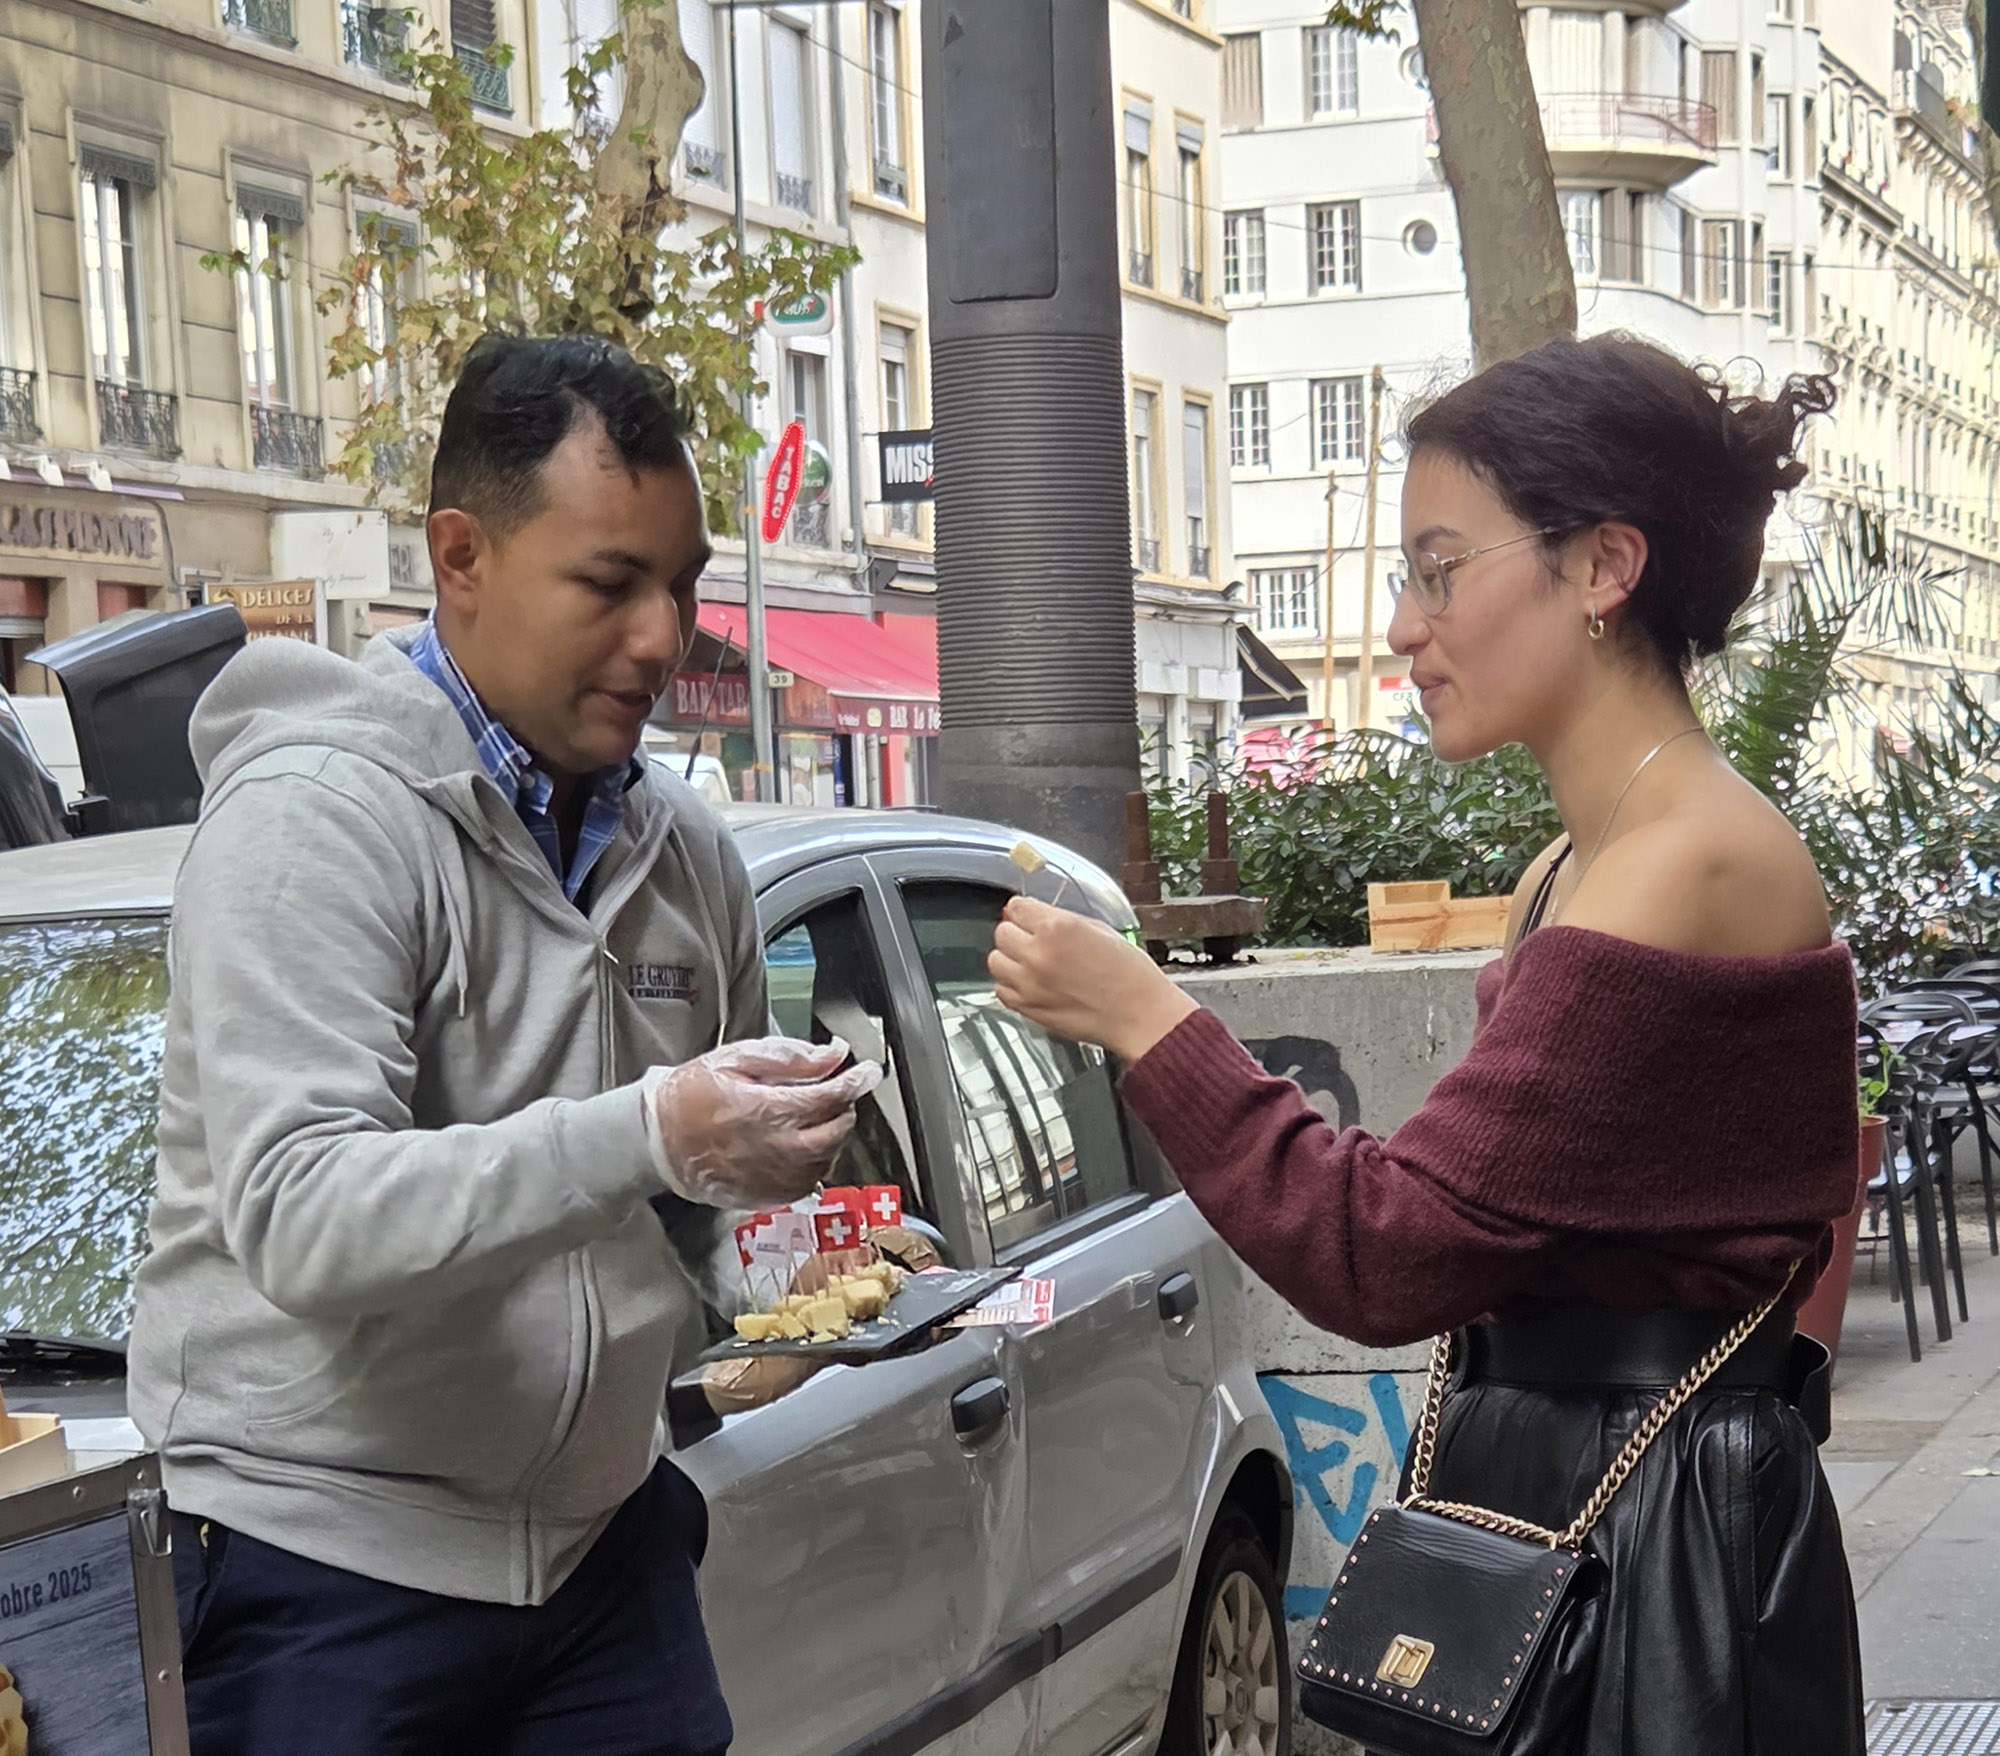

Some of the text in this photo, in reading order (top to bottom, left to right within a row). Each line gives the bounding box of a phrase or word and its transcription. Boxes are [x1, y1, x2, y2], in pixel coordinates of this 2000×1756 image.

[770, 444, 795, 519] TABAC
[242, 586, 314, 608] DÉLICES
[774, 675, 788, 684] 39
[629, 964, 646, 986] LE
[47, 1562, 92, 1603] 2025
